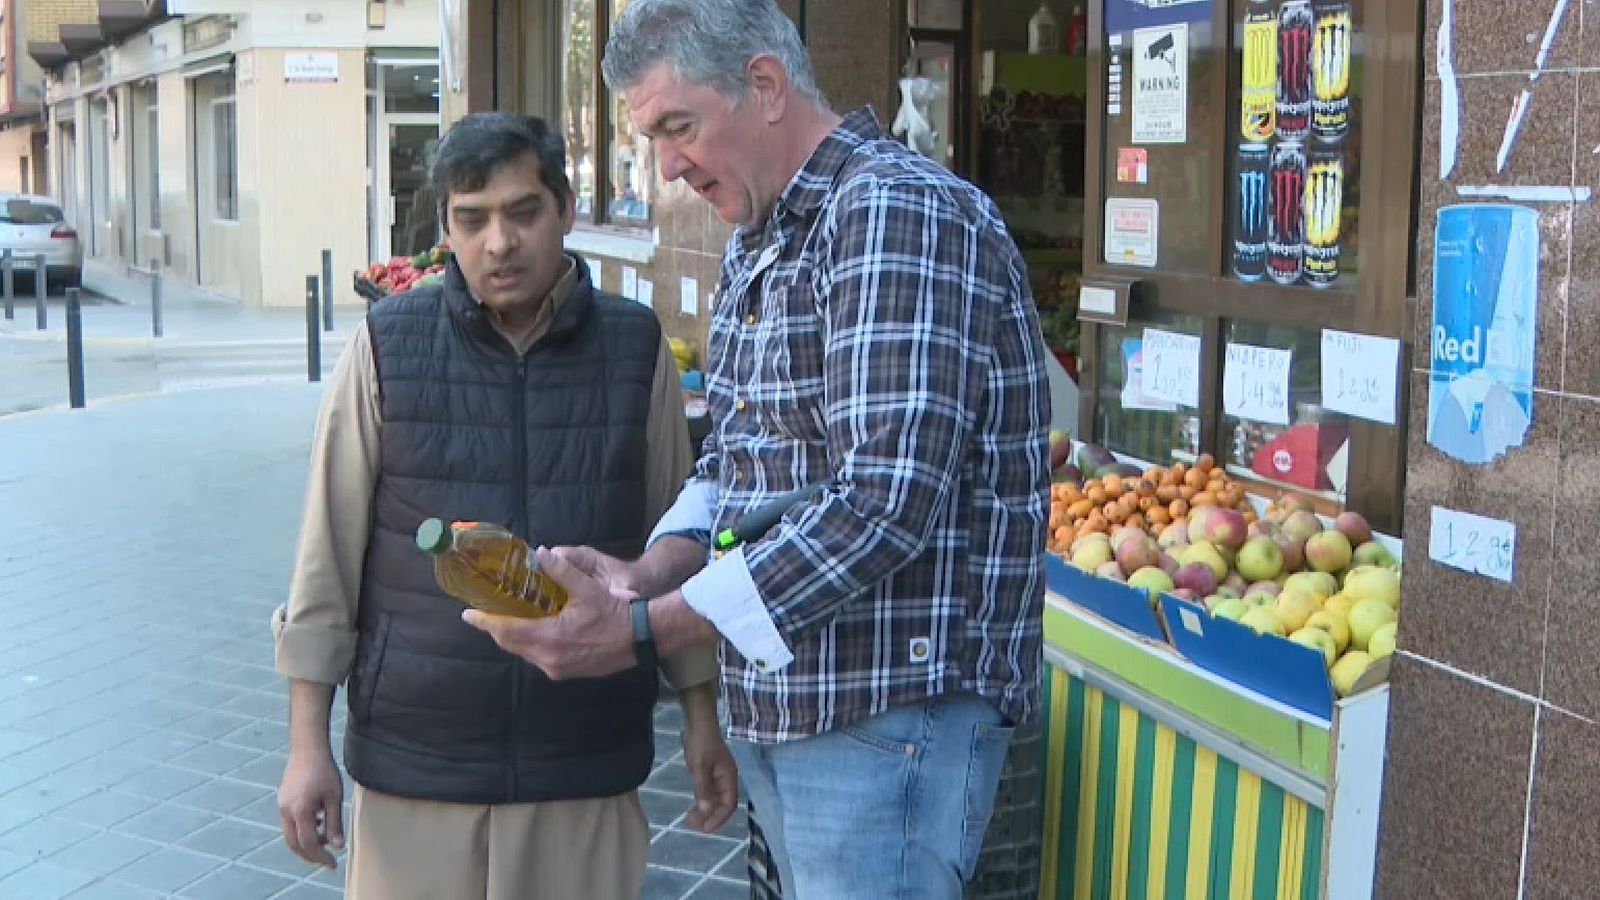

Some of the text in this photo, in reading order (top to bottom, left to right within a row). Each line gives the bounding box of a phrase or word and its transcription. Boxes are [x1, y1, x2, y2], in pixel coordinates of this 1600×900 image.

[1140, 76, 1180, 92] WARNING
[1434, 325, 1480, 363] Red
[1227, 347, 1284, 371] NISPERO
